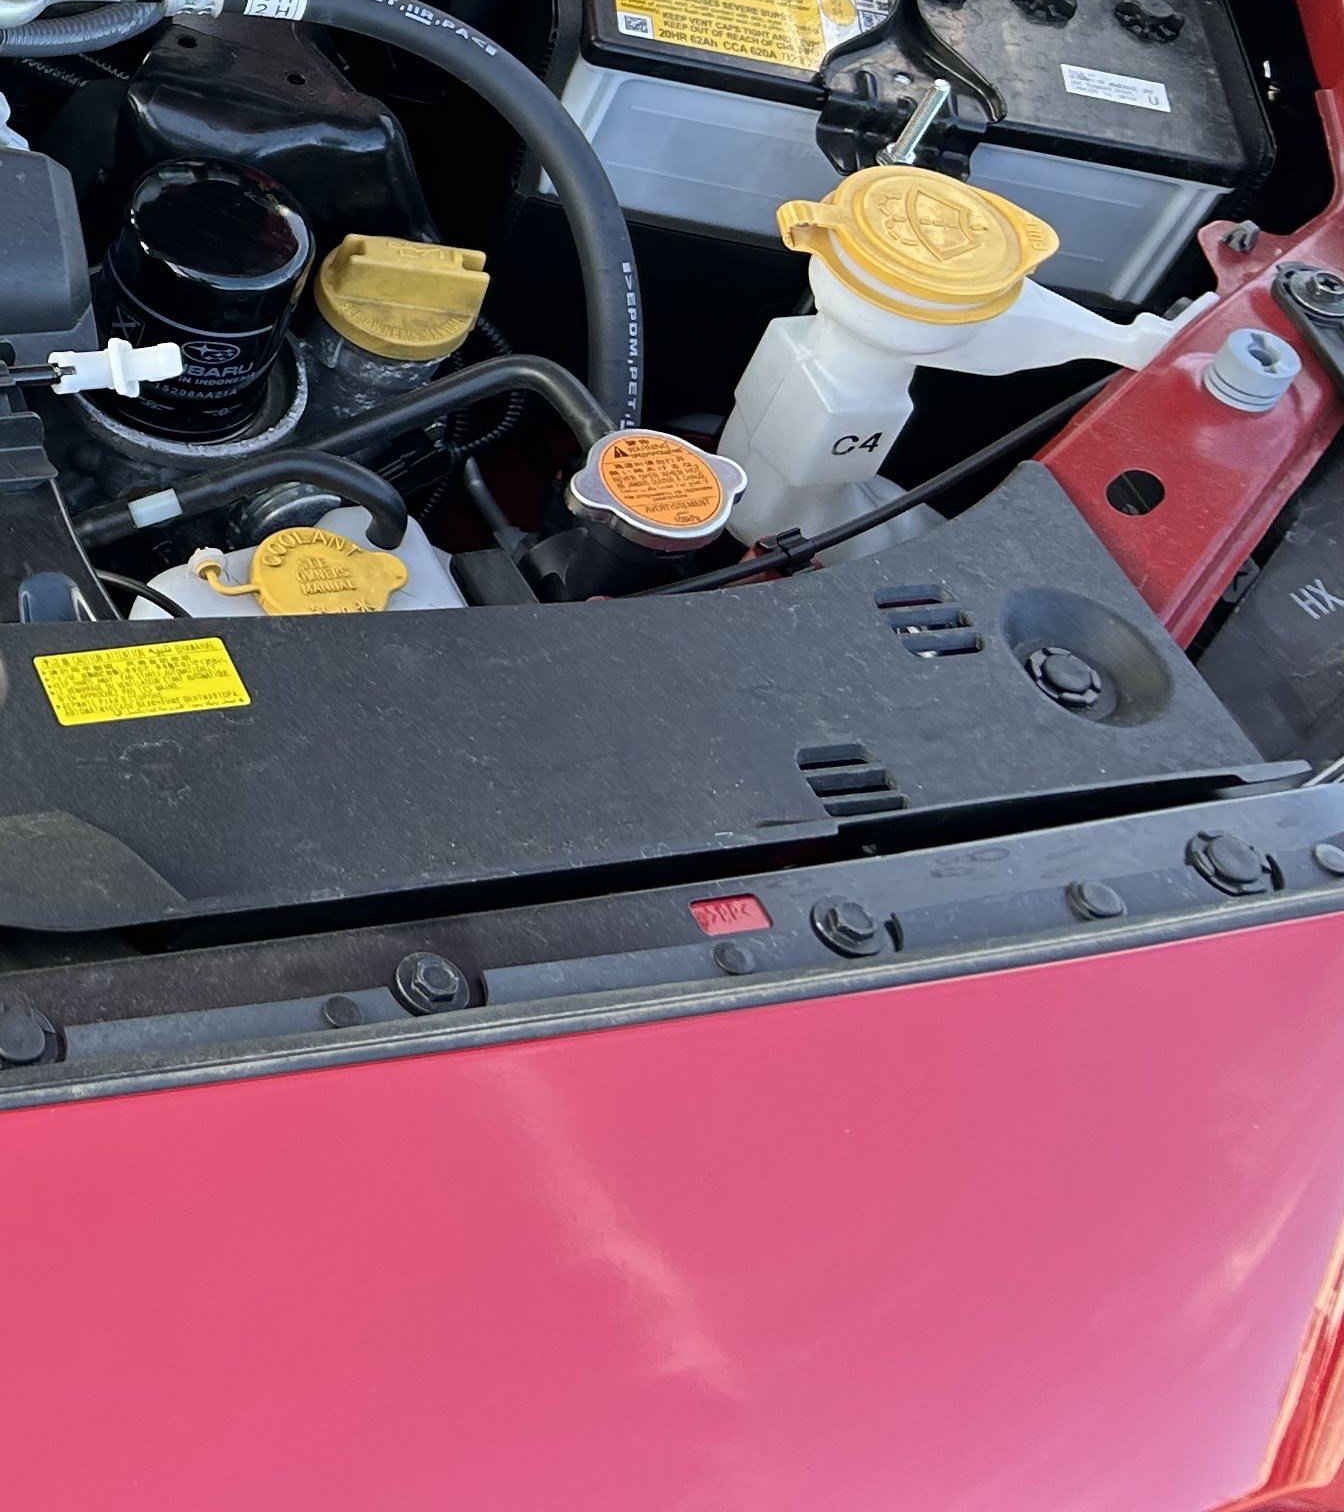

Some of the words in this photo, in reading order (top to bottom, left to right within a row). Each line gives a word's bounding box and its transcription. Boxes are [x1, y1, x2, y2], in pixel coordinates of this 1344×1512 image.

[722, 2, 760, 17] SEVERE
[663, 12, 688, 24] KEEP
[690, 16, 714, 28] VENT
[663, 20, 689, 32] KEEP
[690, 24, 709, 36] OUT
[659, 28, 688, 42] 20HR
[723, 40, 748, 54] CCA
[183, 362, 254, 377] BARU
[831, 432, 883, 456] C4
[262, 530, 362, 567] COOLANT
[298, 556, 327, 568] SEE
[301, 579, 358, 595] MANUAL
[1290, 579, 1344, 620] HX
